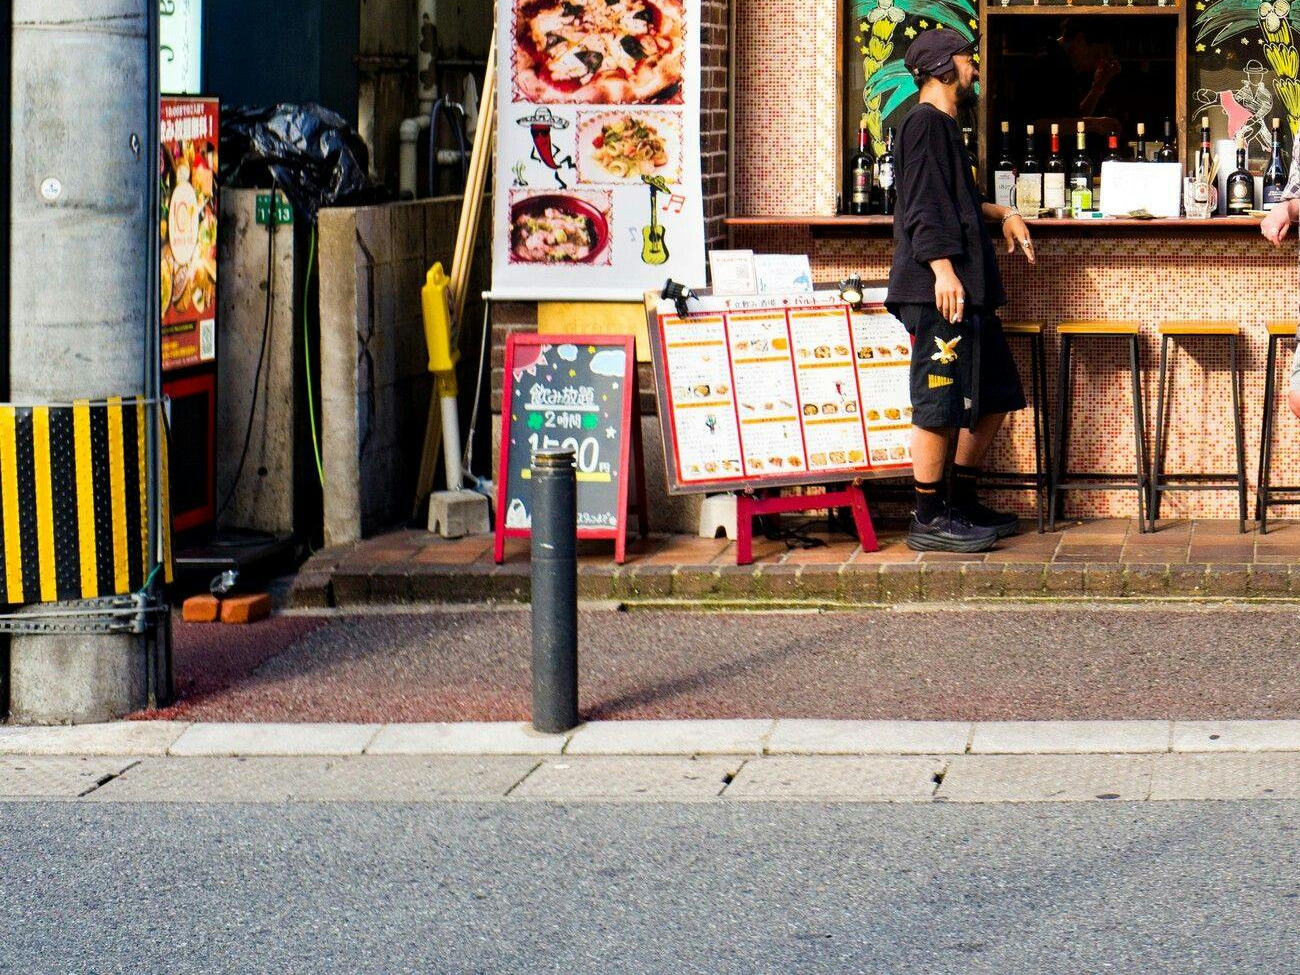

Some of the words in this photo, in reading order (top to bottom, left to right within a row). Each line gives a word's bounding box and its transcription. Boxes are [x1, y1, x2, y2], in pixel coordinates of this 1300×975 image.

[529, 382, 595, 406] 飲み放題
[544, 410, 582, 429] 2時間
